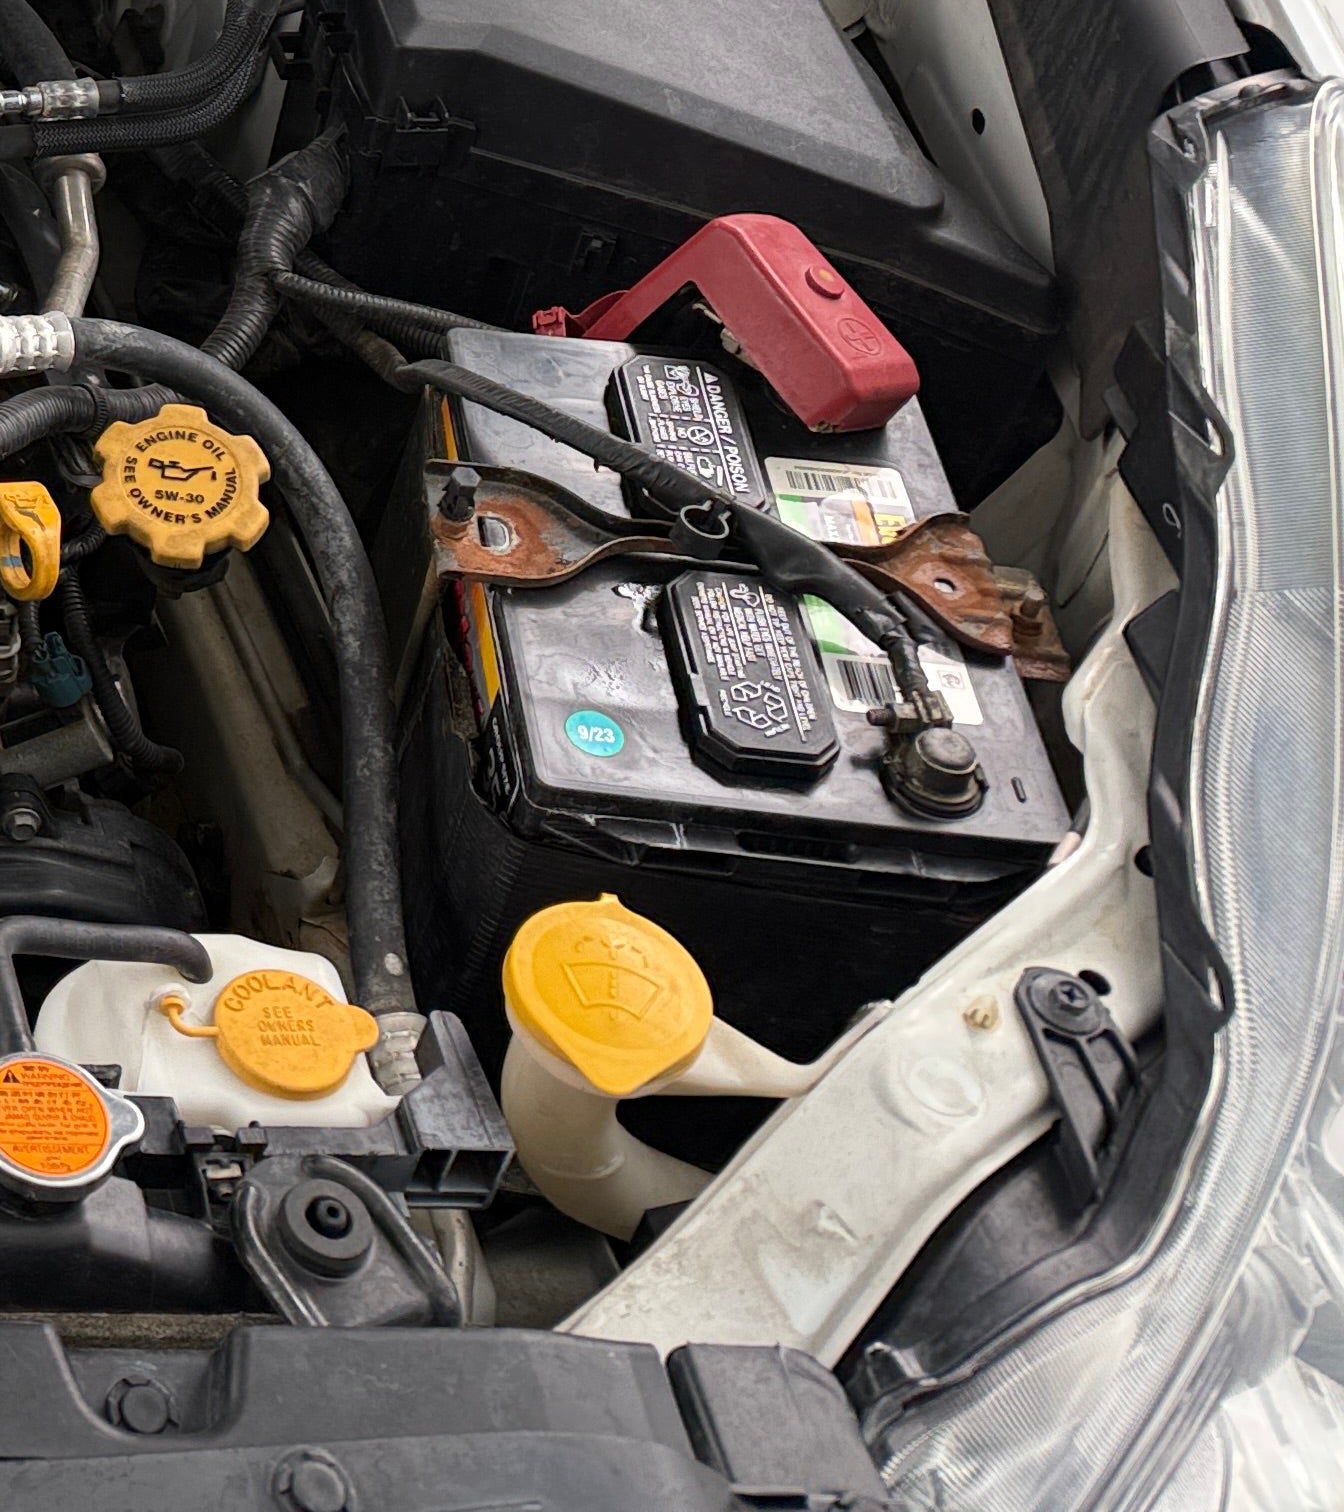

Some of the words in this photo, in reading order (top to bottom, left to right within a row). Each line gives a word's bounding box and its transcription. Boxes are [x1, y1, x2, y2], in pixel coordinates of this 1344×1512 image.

[135, 430, 199, 453] ENGINE
[202, 438, 228, 462] OIL
[705, 383, 733, 434] DANGER
[722, 445, 749, 492] POISON
[124, 455, 138, 483] SEE
[128, 488, 202, 525] OWNER'S
[154, 489, 205, 505] 5W-30
[204, 467, 239, 520] MANUAL
[576, 723, 616, 745] 9/23
[223, 973, 336, 1012] COOLANT
[257, 1019, 316, 1033] OWNERS
[262, 1006, 293, 1019] SEE
[260, 1033, 321, 1047] MANUAL
